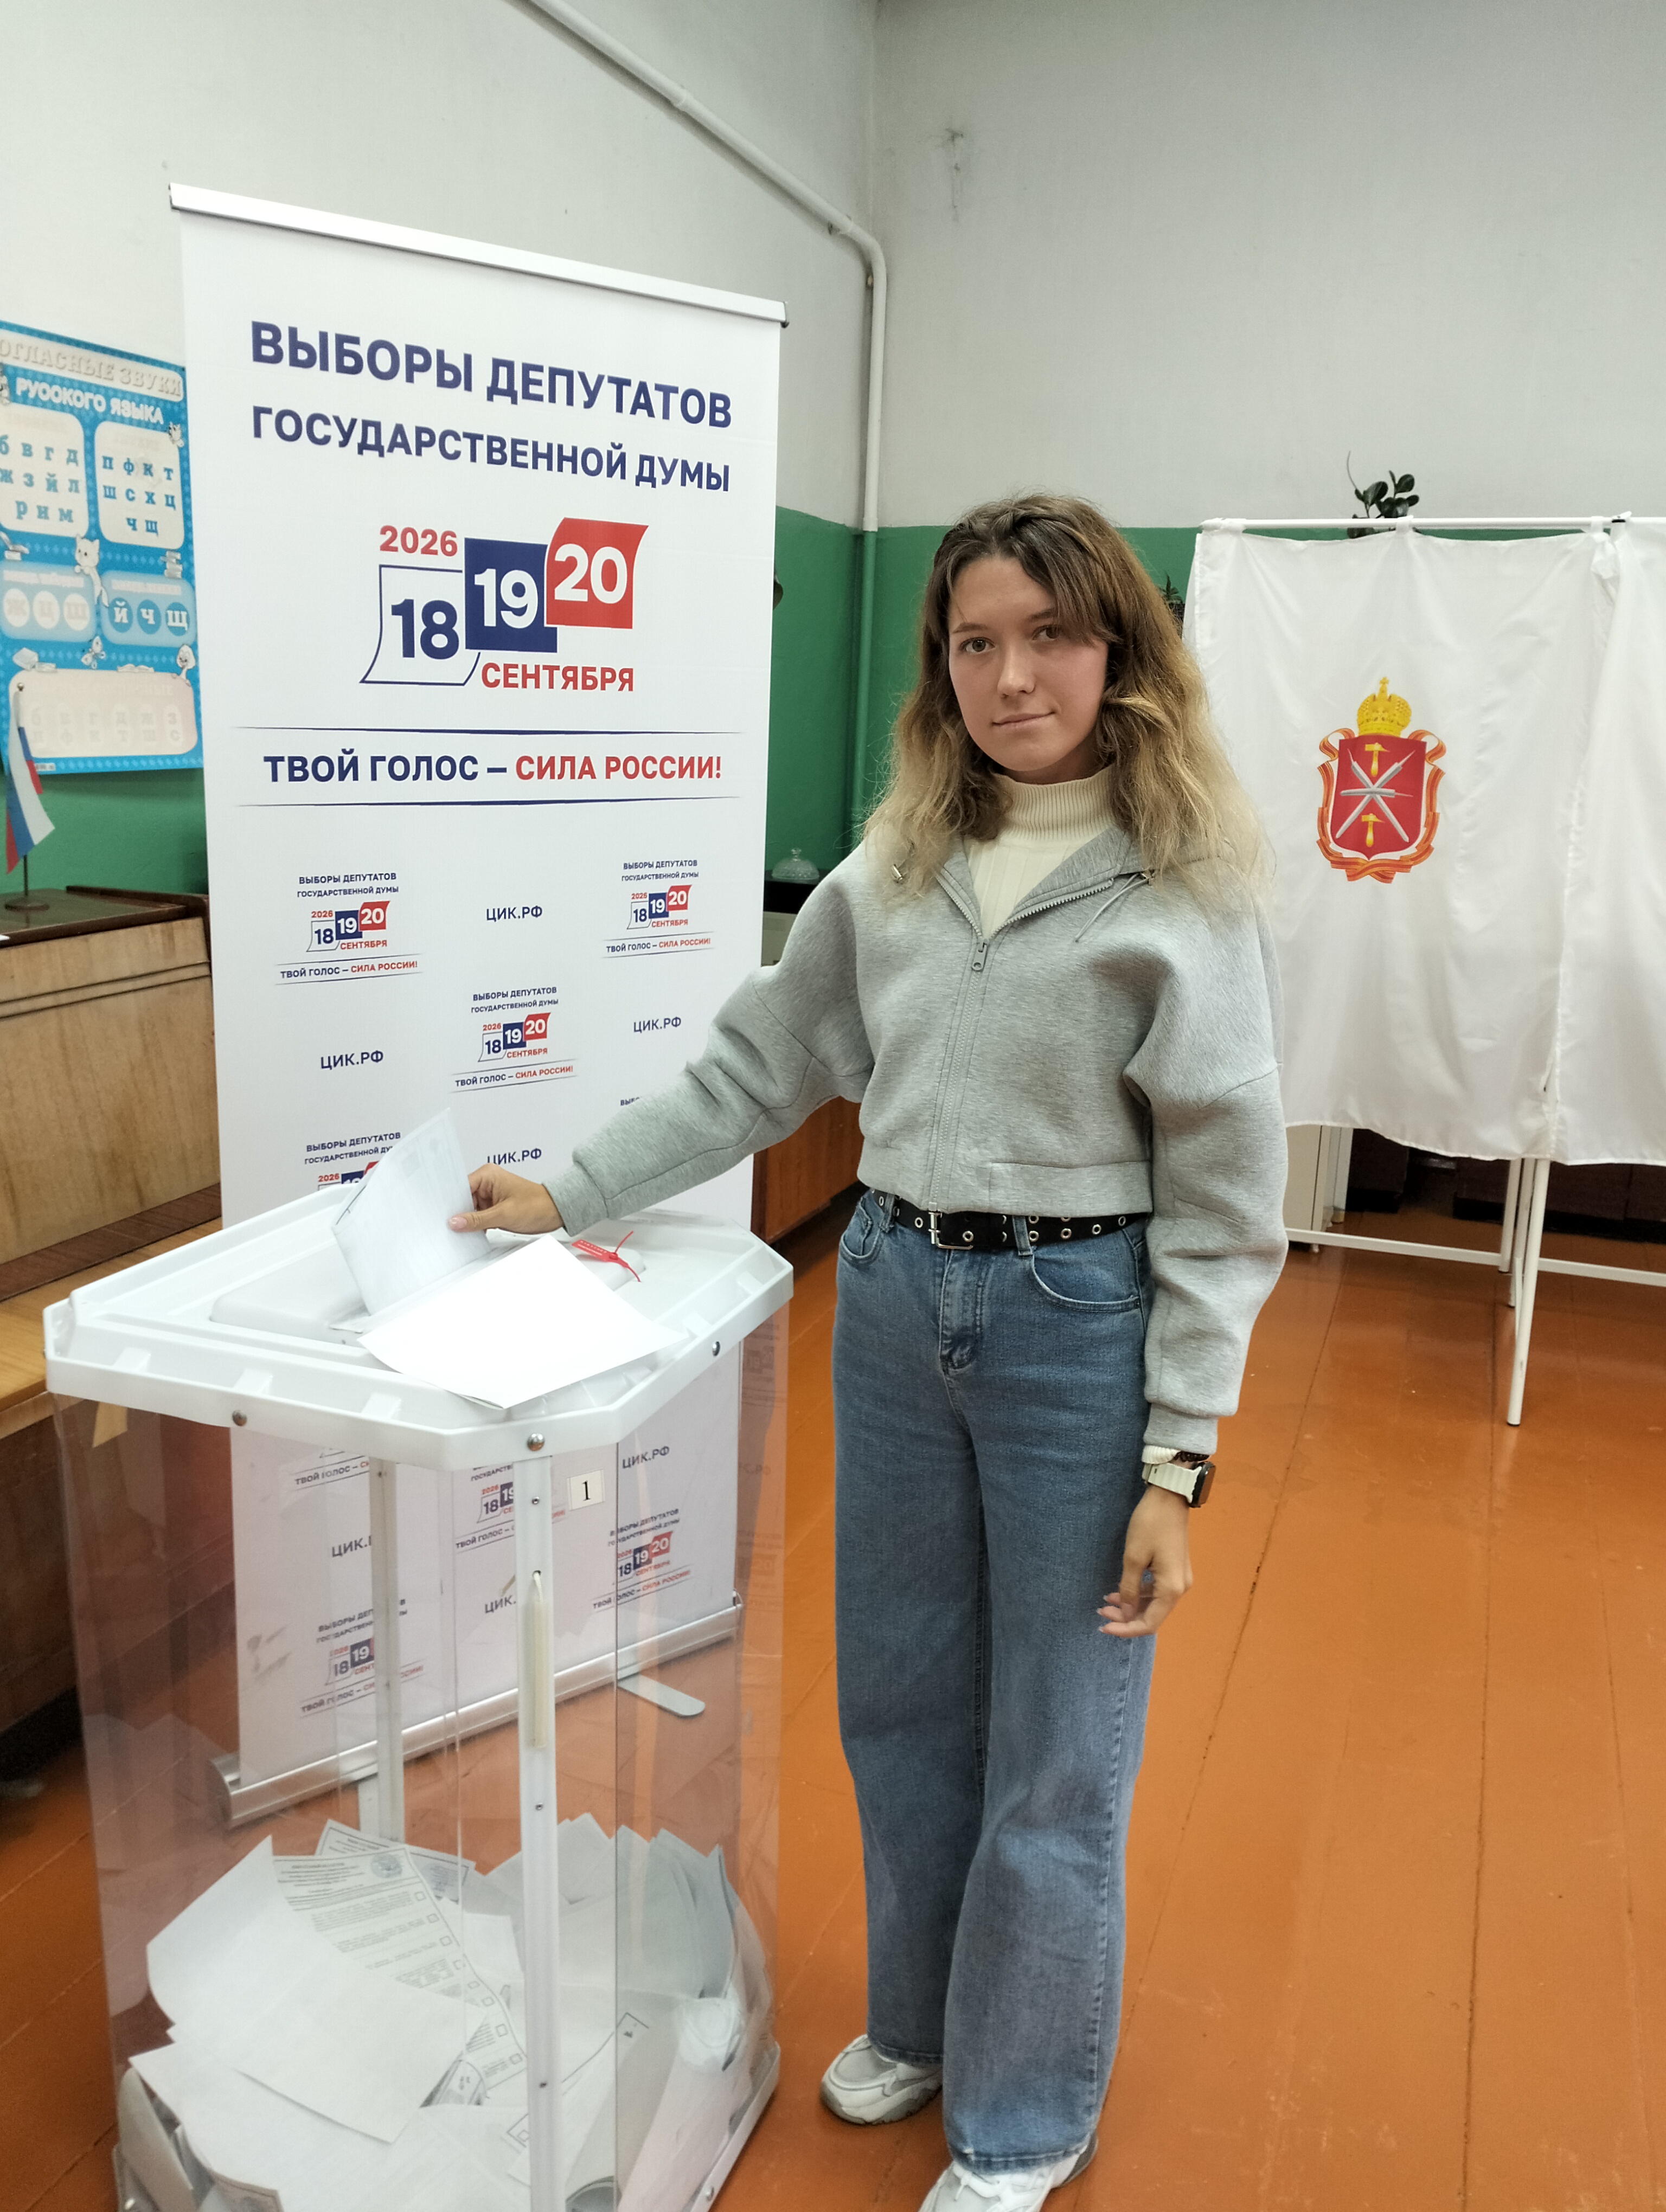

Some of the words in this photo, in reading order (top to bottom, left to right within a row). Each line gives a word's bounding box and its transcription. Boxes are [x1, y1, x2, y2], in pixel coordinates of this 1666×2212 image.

[0, 339, 115, 381] ОГЛАСНЫЕ
[120, 367, 181, 396] ЗВУКИ
[251, 320, 472, 392] ВЫБОРЫ
[486, 357, 732, 428] ДЕПУТАТОВ
[110, 397, 164, 425] ЯЗЫКА
[21, 442, 33, 457] в
[45, 446, 54, 460] г
[67, 449, 78, 466] д
[252, 406, 626, 479] ГОСУДАРСТВЕННОЙ
[636, 455, 729, 491] ДУМЫ
[102, 456, 113, 470] п
[124, 458, 134, 475] ф
[143, 463, 153, 477] к
[164, 467, 173, 480] т
[23, 473, 34, 487] з
[46, 473, 58, 493] й
[68, 479, 80, 493] л
[103, 485, 117, 499] ш
[125, 489, 135, 501] с
[145, 491, 156, 505] х
[165, 494, 176, 511] ц
[16, 500, 28, 520] р
[59, 508, 73, 523] м
[126, 517, 137, 531] ч
[145, 520, 158, 537] щ
[380, 525, 457, 556] 2026
[392, 599, 459, 659] 18
[475, 568, 539, 628] 19
[554, 543, 627, 604] 20
[114, 600, 128, 623] й
[140, 608, 155, 624] ч
[167, 610, 188, 631] щ
[480, 663, 633, 691] СЕНТЯБРЯ
[264, 749, 359, 782] ТВОЙ
[370, 755, 478, 781] ГОЛОС
[515, 756, 597, 781] СИЛА
[605, 756, 722, 780] РОССИИ!
[624, 861, 653, 870] ВЫБОРЫ
[656, 860, 697, 869] ДЕПУТАТОВ
[299, 876, 340, 884] ВЫБОРЫ
[343, 873, 396, 883] ДЕПУТАТОВ
[622, 872, 679, 881] ГОСУДАРСТВЕННОЙ
[297, 886, 373, 897] ГОСУДАРСТВЕННОЙ
[486, 905, 542, 922] ЦИК.РФ
[633, 909, 647, 923] 18
[651, 899, 665, 914] 19
[669, 891, 687, 905] 20
[315, 928, 334, 944] 18
[337, 917, 357, 934] 19
[361, 908, 384, 924] 20
[652, 919, 688, 928] СЕНТЯБРЯ
[341, 940, 387, 949] СЕНТЯБРЯ
[606, 943, 626, 953] ТВОЙ
[280, 968, 306, 978] ТВОЙ
[309, 967, 339, 976] ГОЛОС
[351, 964, 376, 973] СИЛА
[379, 961, 418, 970] РОССИИ!
[473, 991, 508, 1001] ВЫБОРЫ
[510, 987, 557, 998] ДЕПУТАТОВ
[471, 1000, 537, 1013] ГОСУДАРСТВЕННОЙ
[633, 1017, 682, 1033] ЦИК.РФ
[485, 1040, 501, 1054] 18
[505, 1029, 522, 1044] 19
[526, 1019, 545, 1034] 20
[321, 1050, 383, 1070] ЦИК.РФ
[507, 1048, 547, 1058] СЕНТЯБРЯ
[456, 1077, 477, 1086] ТВОЙ
[480, 1074, 506, 1083] ГОЛОС
[539, 1066, 573, 1076] РОССИИ!
[306, 1140, 347, 1152] ВЫБОРЫ
[349, 1132, 400, 1147] ДЕПУТАТОВ
[305, 1147, 379, 1164] ГОСУДАРСТВЕННОЙ
[318, 1173, 339, 1182] 2026
[623, 1446, 669, 1469] ЦИК.РФ
[295, 1473, 319, 1484] ТВОЙ
[582, 1480, 591, 1501] 1
[484, 1500, 498, 1514] 18
[332, 1535, 371, 1557] ЦИК.
[456, 1537, 476, 1548] ТВОЙ
[478, 1529, 503, 1542] ГОЛОС
[619, 1563, 631, 1576] 18
[635, 1551, 649, 1564] 19
[652, 1538, 669, 1553] 20
[485, 1595, 516, 1613] ЦИК.
[354, 1647, 370, 1661] 19
